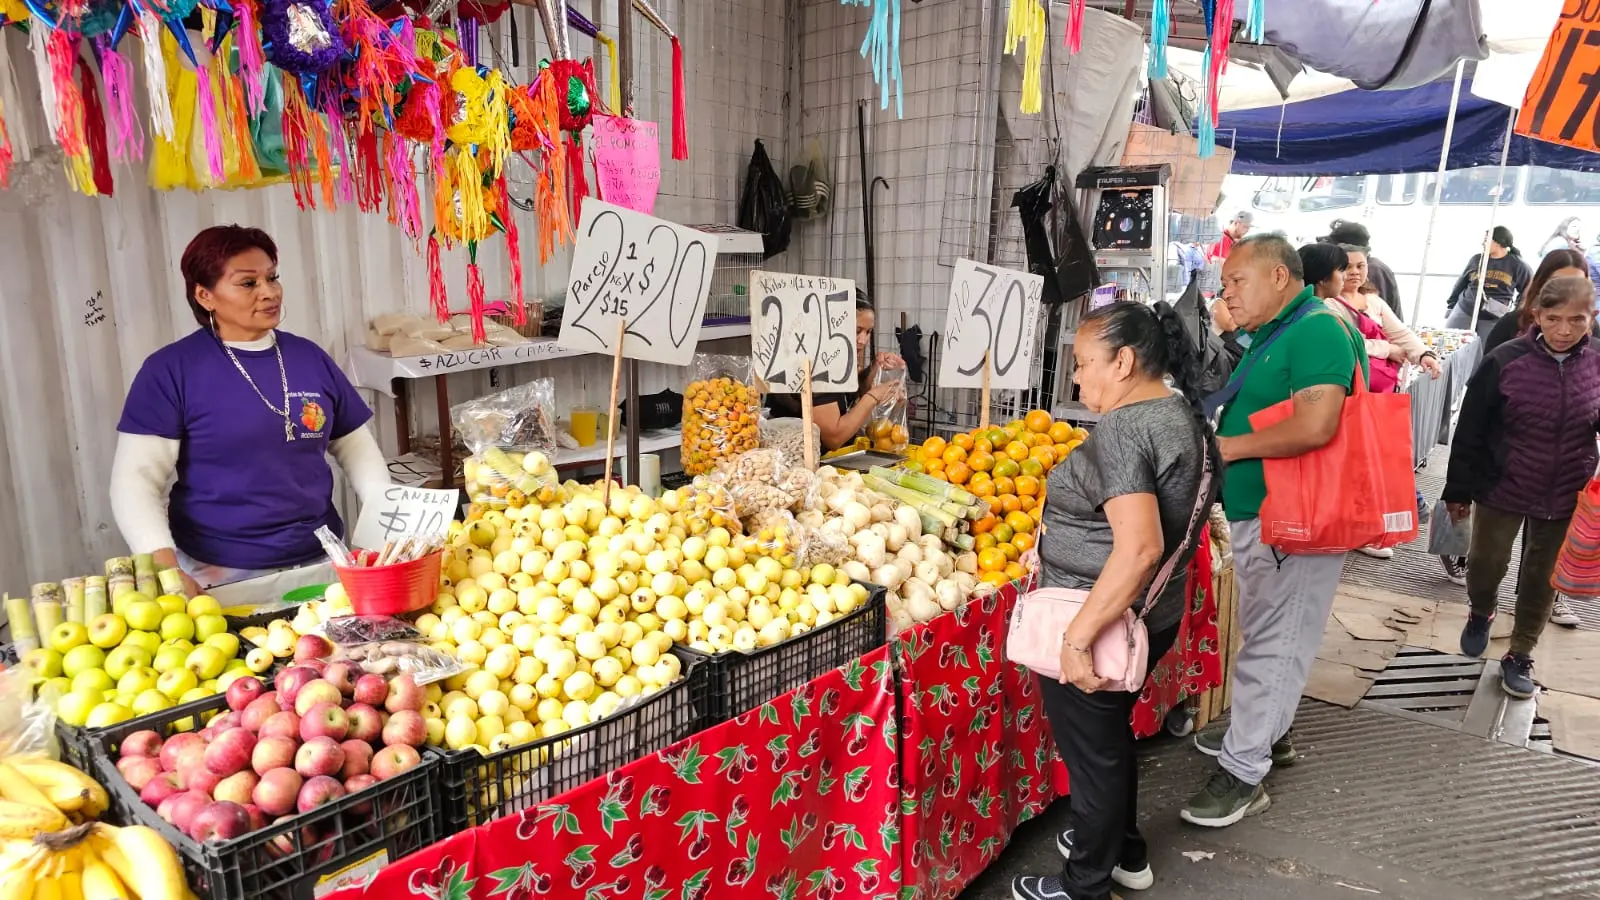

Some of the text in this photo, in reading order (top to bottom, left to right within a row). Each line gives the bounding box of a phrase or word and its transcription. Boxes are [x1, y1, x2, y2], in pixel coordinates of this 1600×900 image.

[760, 278, 787, 294] Kilos
[600, 291, 628, 315] $15
[957, 266, 1025, 376] 30
[753, 324, 778, 367] Kilos
[761, 295, 786, 385] 2
[803, 290, 854, 385] 25
[435, 349, 502, 369] AZUCAR
[384, 487, 450, 504] CANELA
[378, 505, 443, 540] $10
